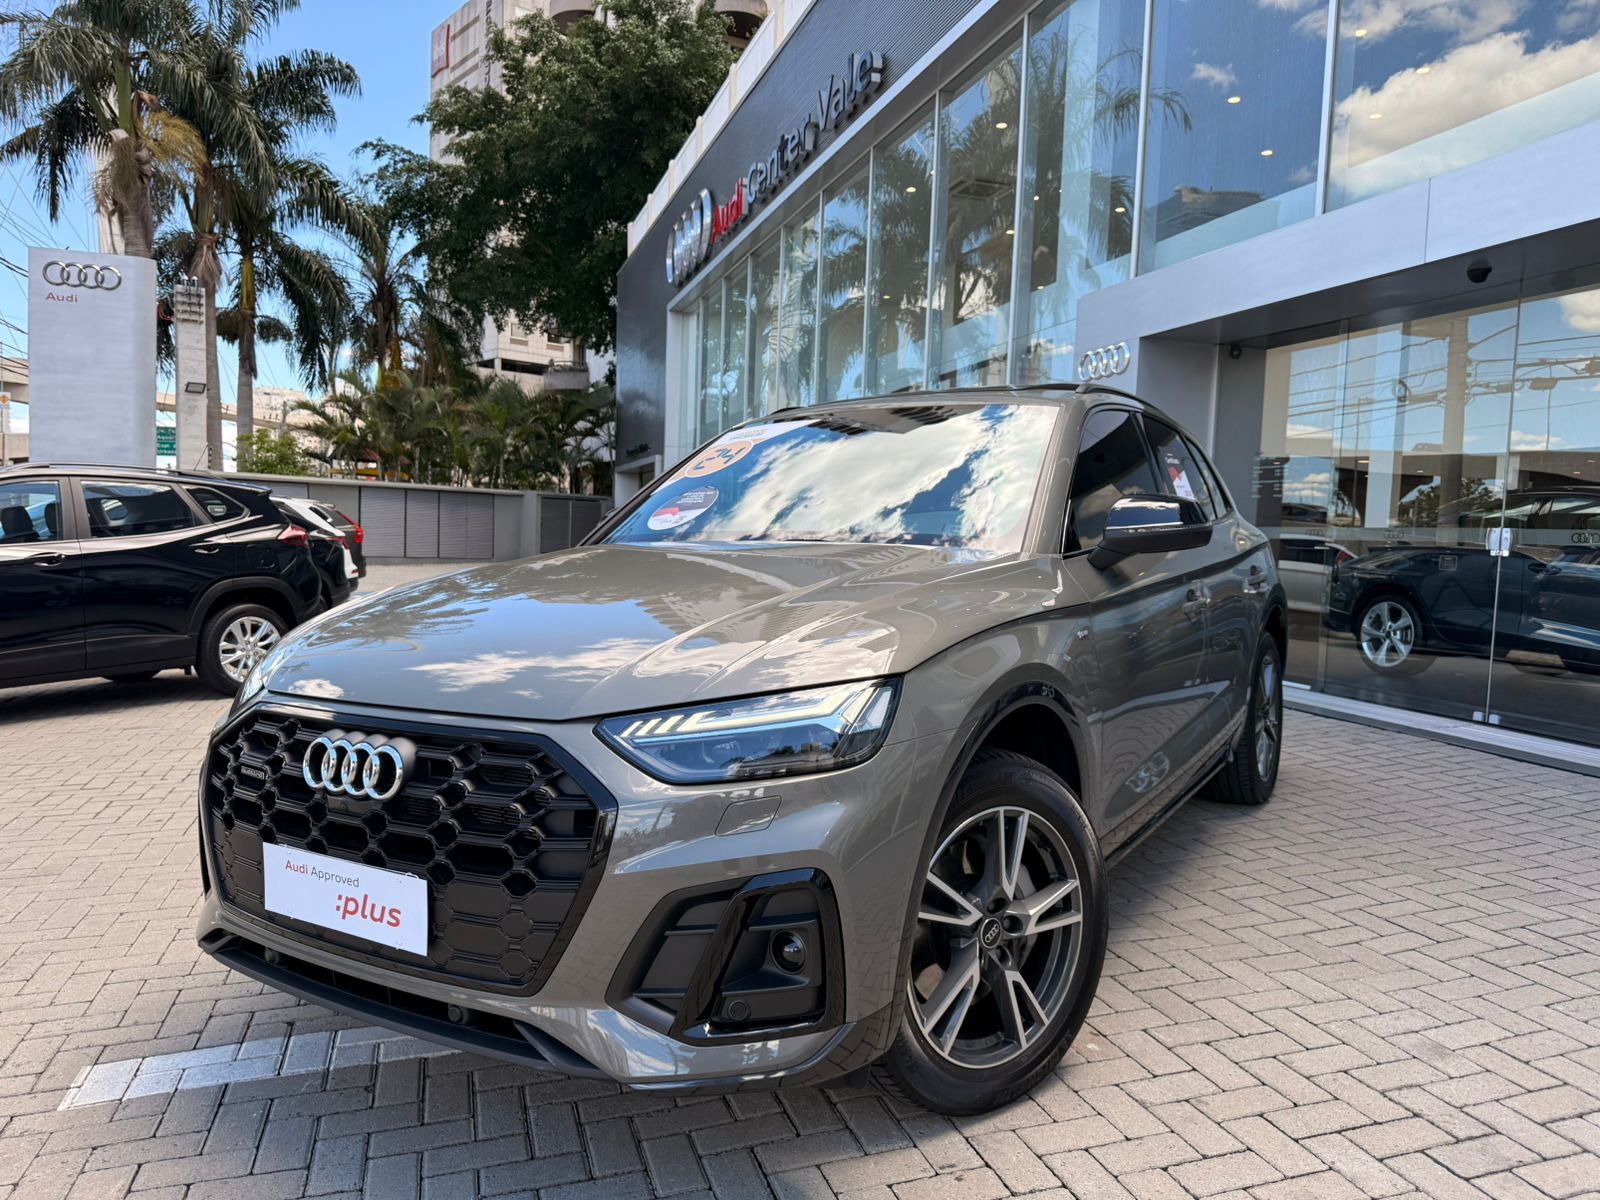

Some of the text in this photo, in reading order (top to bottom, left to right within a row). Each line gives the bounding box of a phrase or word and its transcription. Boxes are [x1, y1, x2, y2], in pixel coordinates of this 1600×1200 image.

[713, 50, 881, 243] Audi Center Vale
[46, 292, 78, 303] Audi
[285, 859, 360, 888] Audi Approved
[335, 893, 402, 928] :plus
